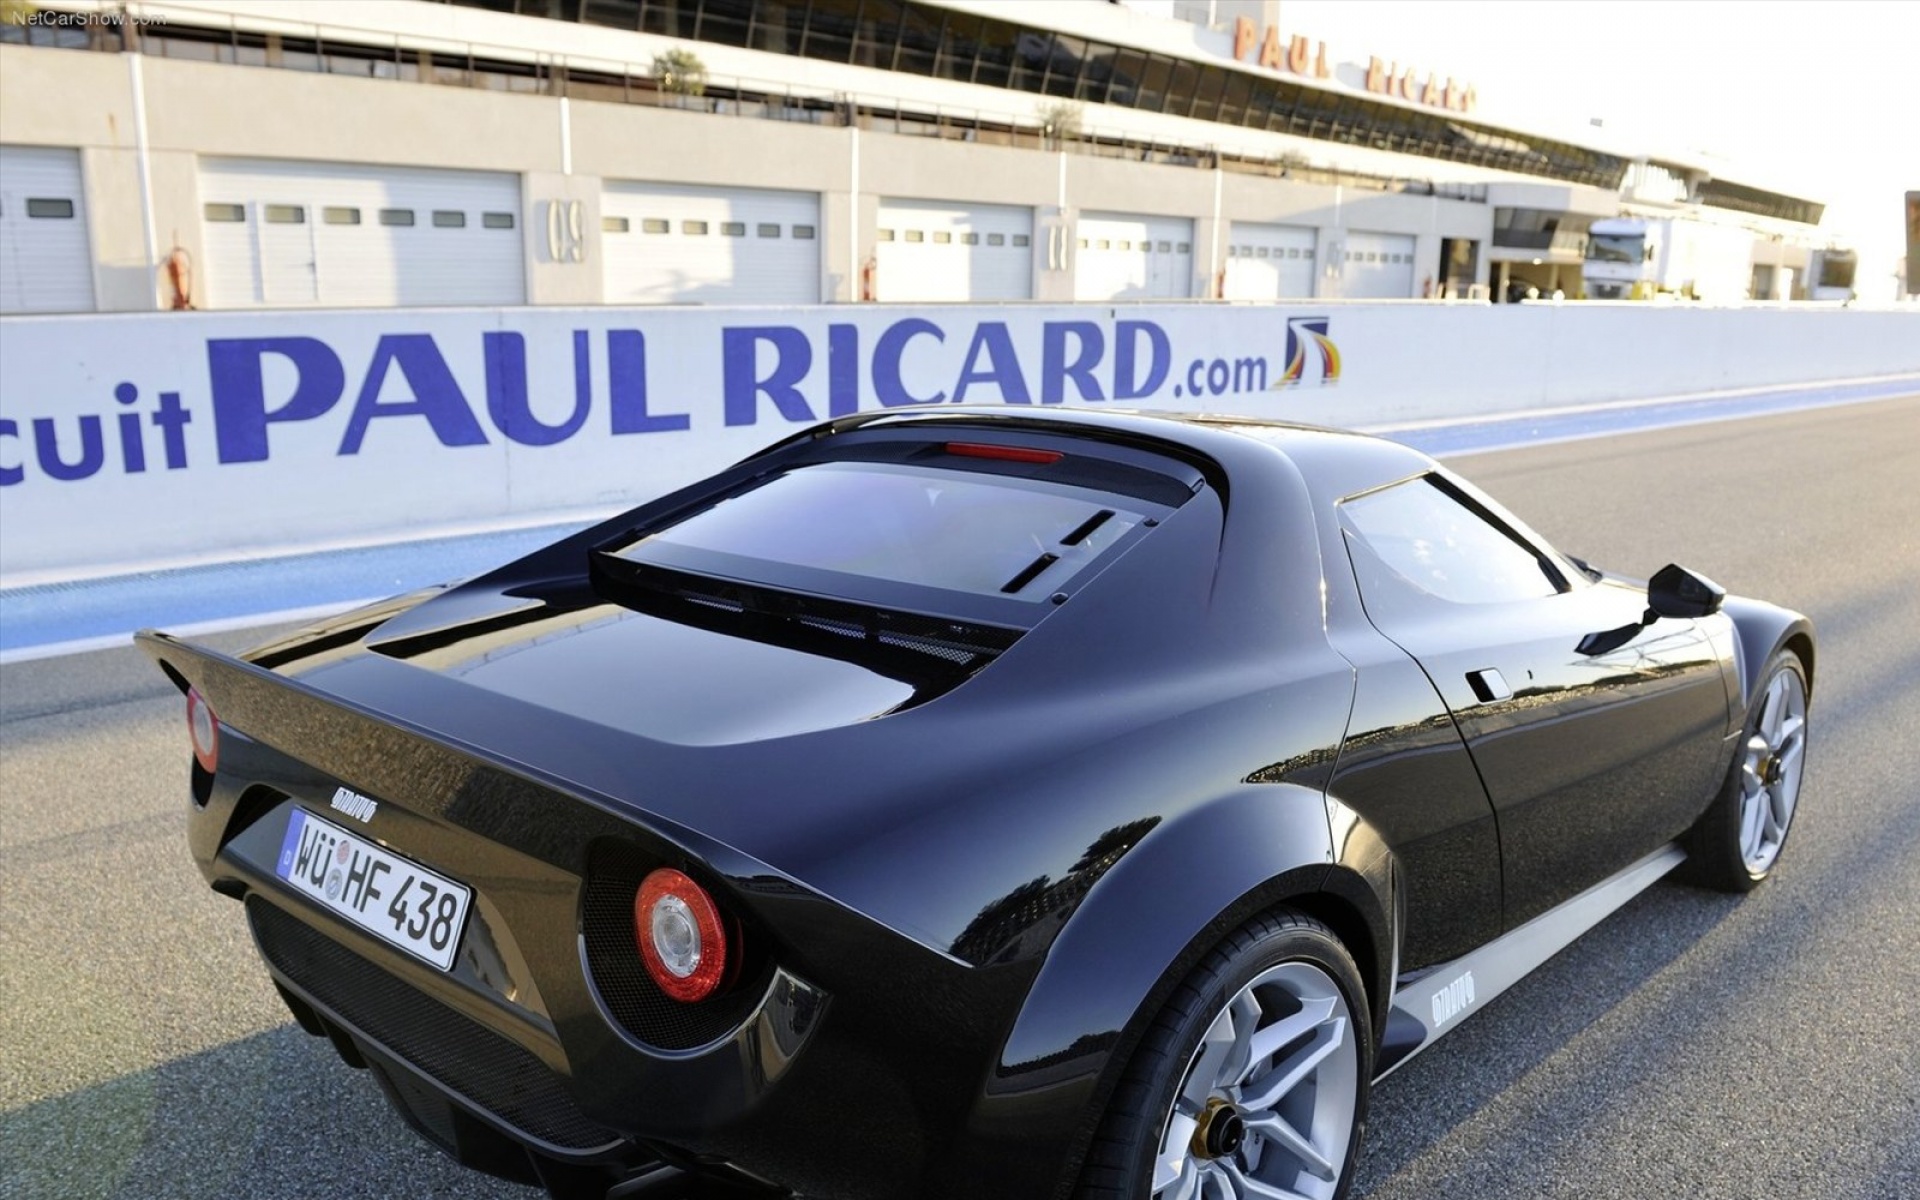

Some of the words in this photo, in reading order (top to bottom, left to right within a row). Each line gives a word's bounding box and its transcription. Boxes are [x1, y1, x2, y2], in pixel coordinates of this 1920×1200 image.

[1234, 16, 1330, 79] PAUL
[206, 328, 691, 465] PAUL
[294, 823, 336, 889] WÜ
[341, 849, 392, 913] HF
[387, 875, 459, 951] 438
